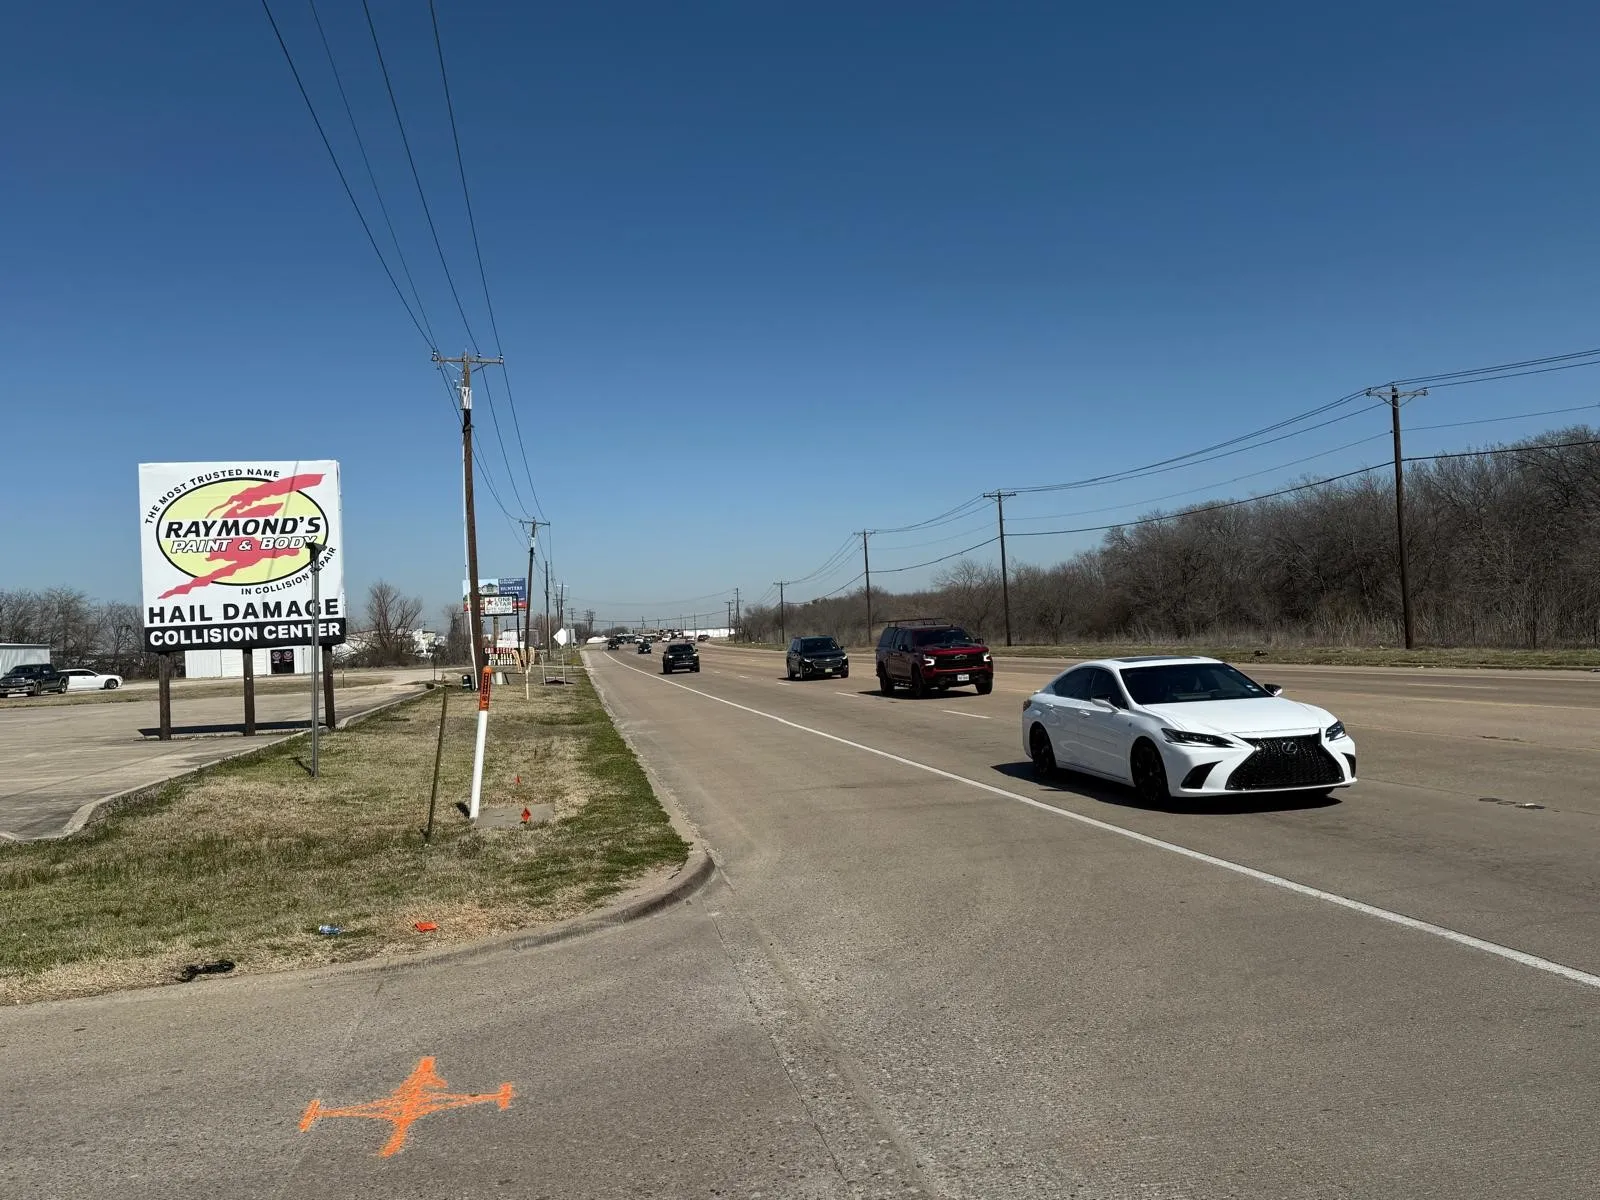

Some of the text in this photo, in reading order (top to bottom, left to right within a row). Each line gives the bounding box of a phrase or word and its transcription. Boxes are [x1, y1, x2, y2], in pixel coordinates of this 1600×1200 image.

[145, 469, 279, 524] THE MOST TRUSTED NAME
[165, 517, 321, 538] RAYMOND'S
[171, 536, 317, 554] PAINT & BODY
[255, 574, 309, 594] COLLISION
[149, 599, 338, 624] HAIL DAMAGE
[150, 623, 340, 646] COLLISION CENTER
